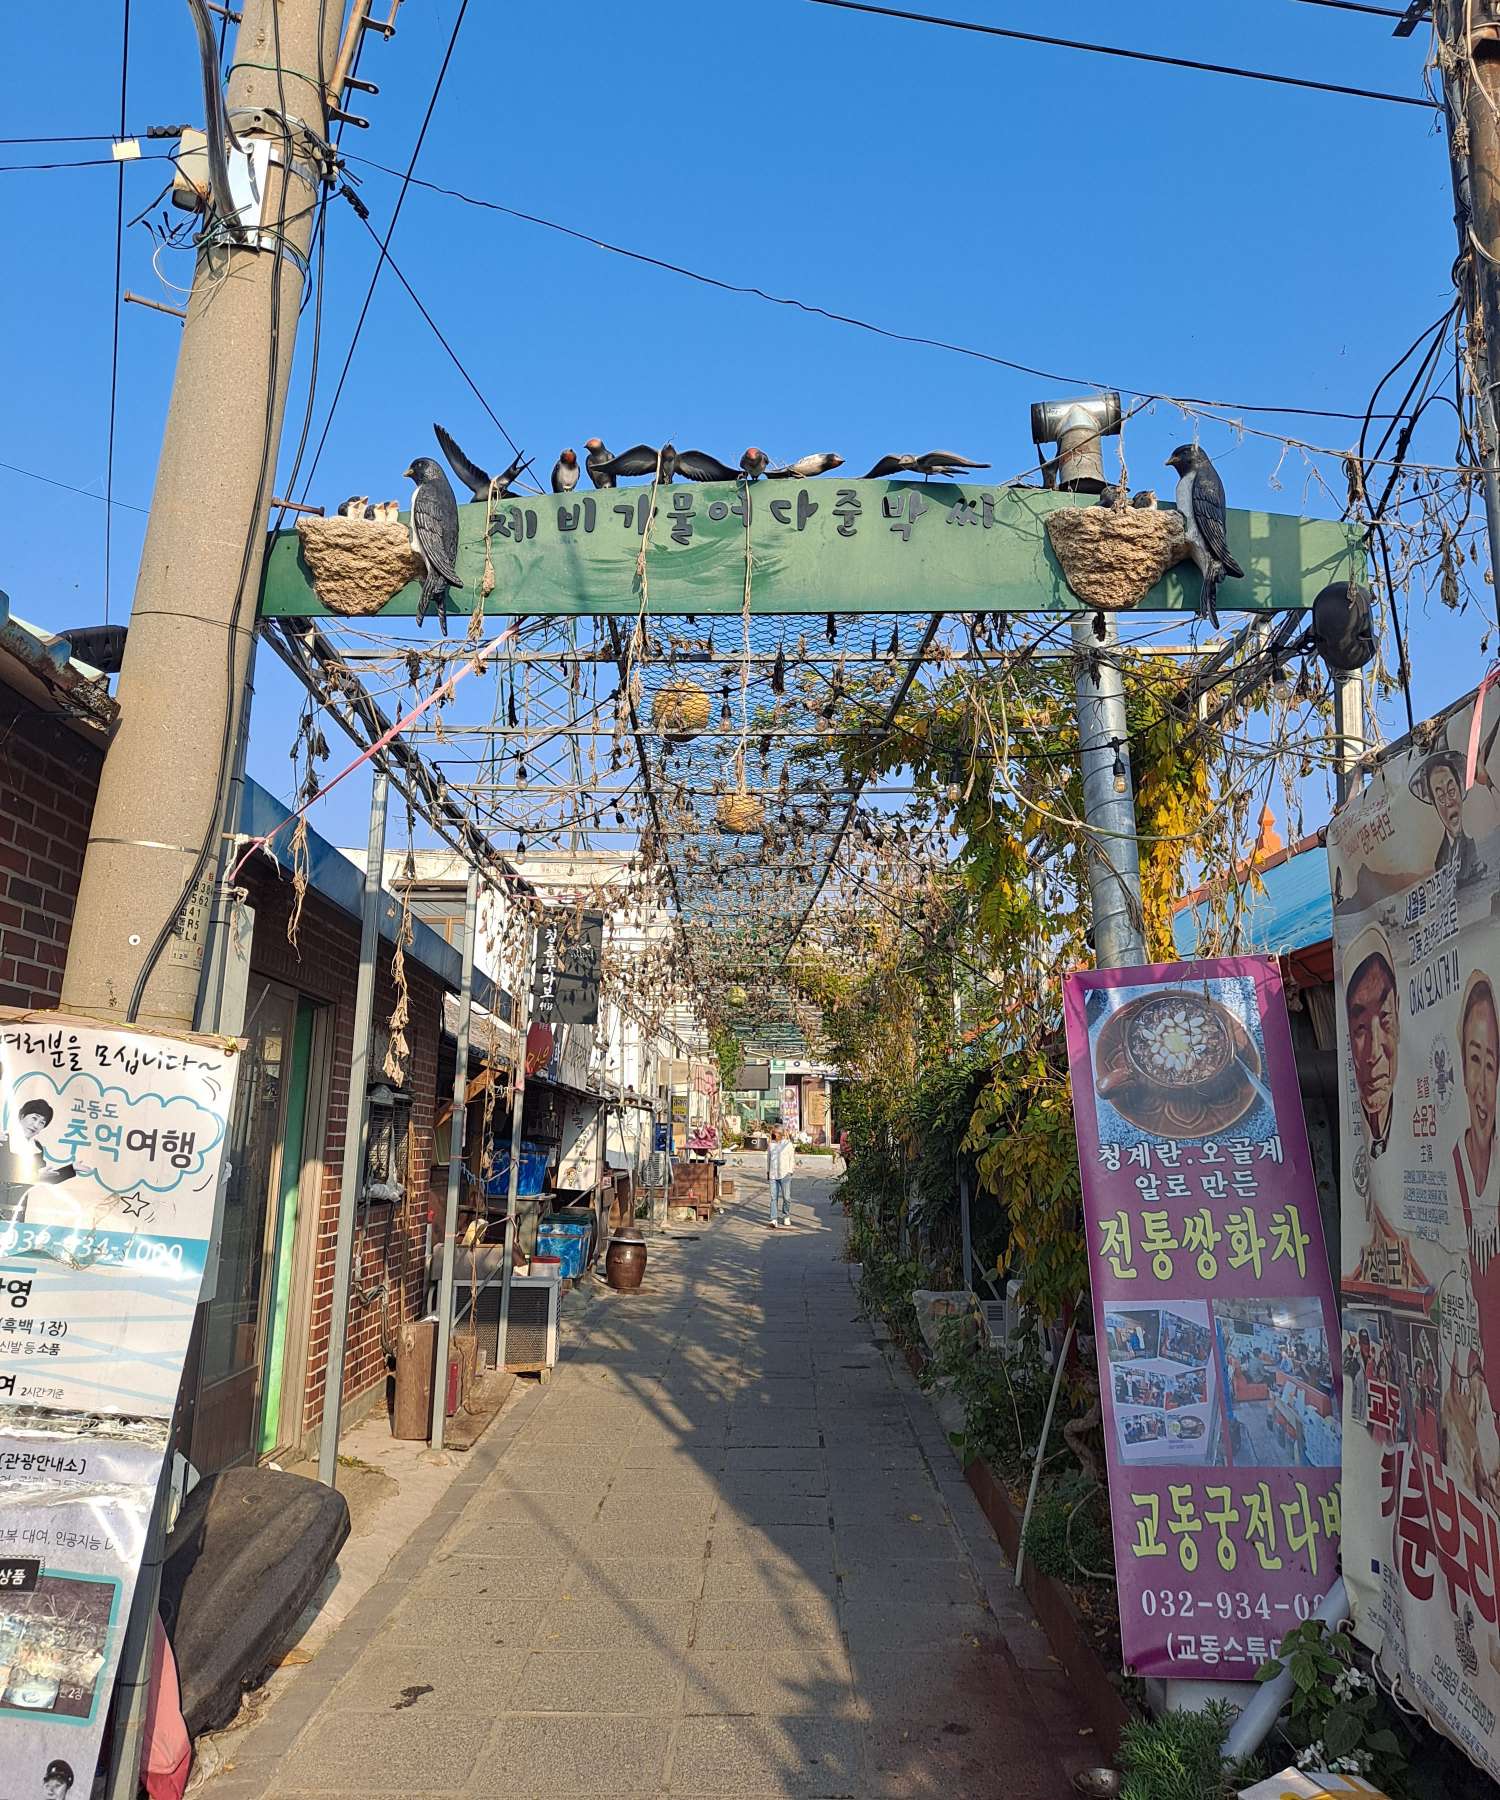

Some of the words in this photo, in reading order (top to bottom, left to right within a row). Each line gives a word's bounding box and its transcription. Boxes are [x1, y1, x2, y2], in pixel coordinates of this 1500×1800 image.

[70, 1098, 119, 1119] 교동도
[1135, 1173, 1192, 1201] 알로
[1200, 1169, 1259, 1199] 만든
[1098, 1203, 1312, 1281] 전통쌍화차
[0, 1278, 33, 1308] 영
[56, 1531, 102, 1551] 인공지능
